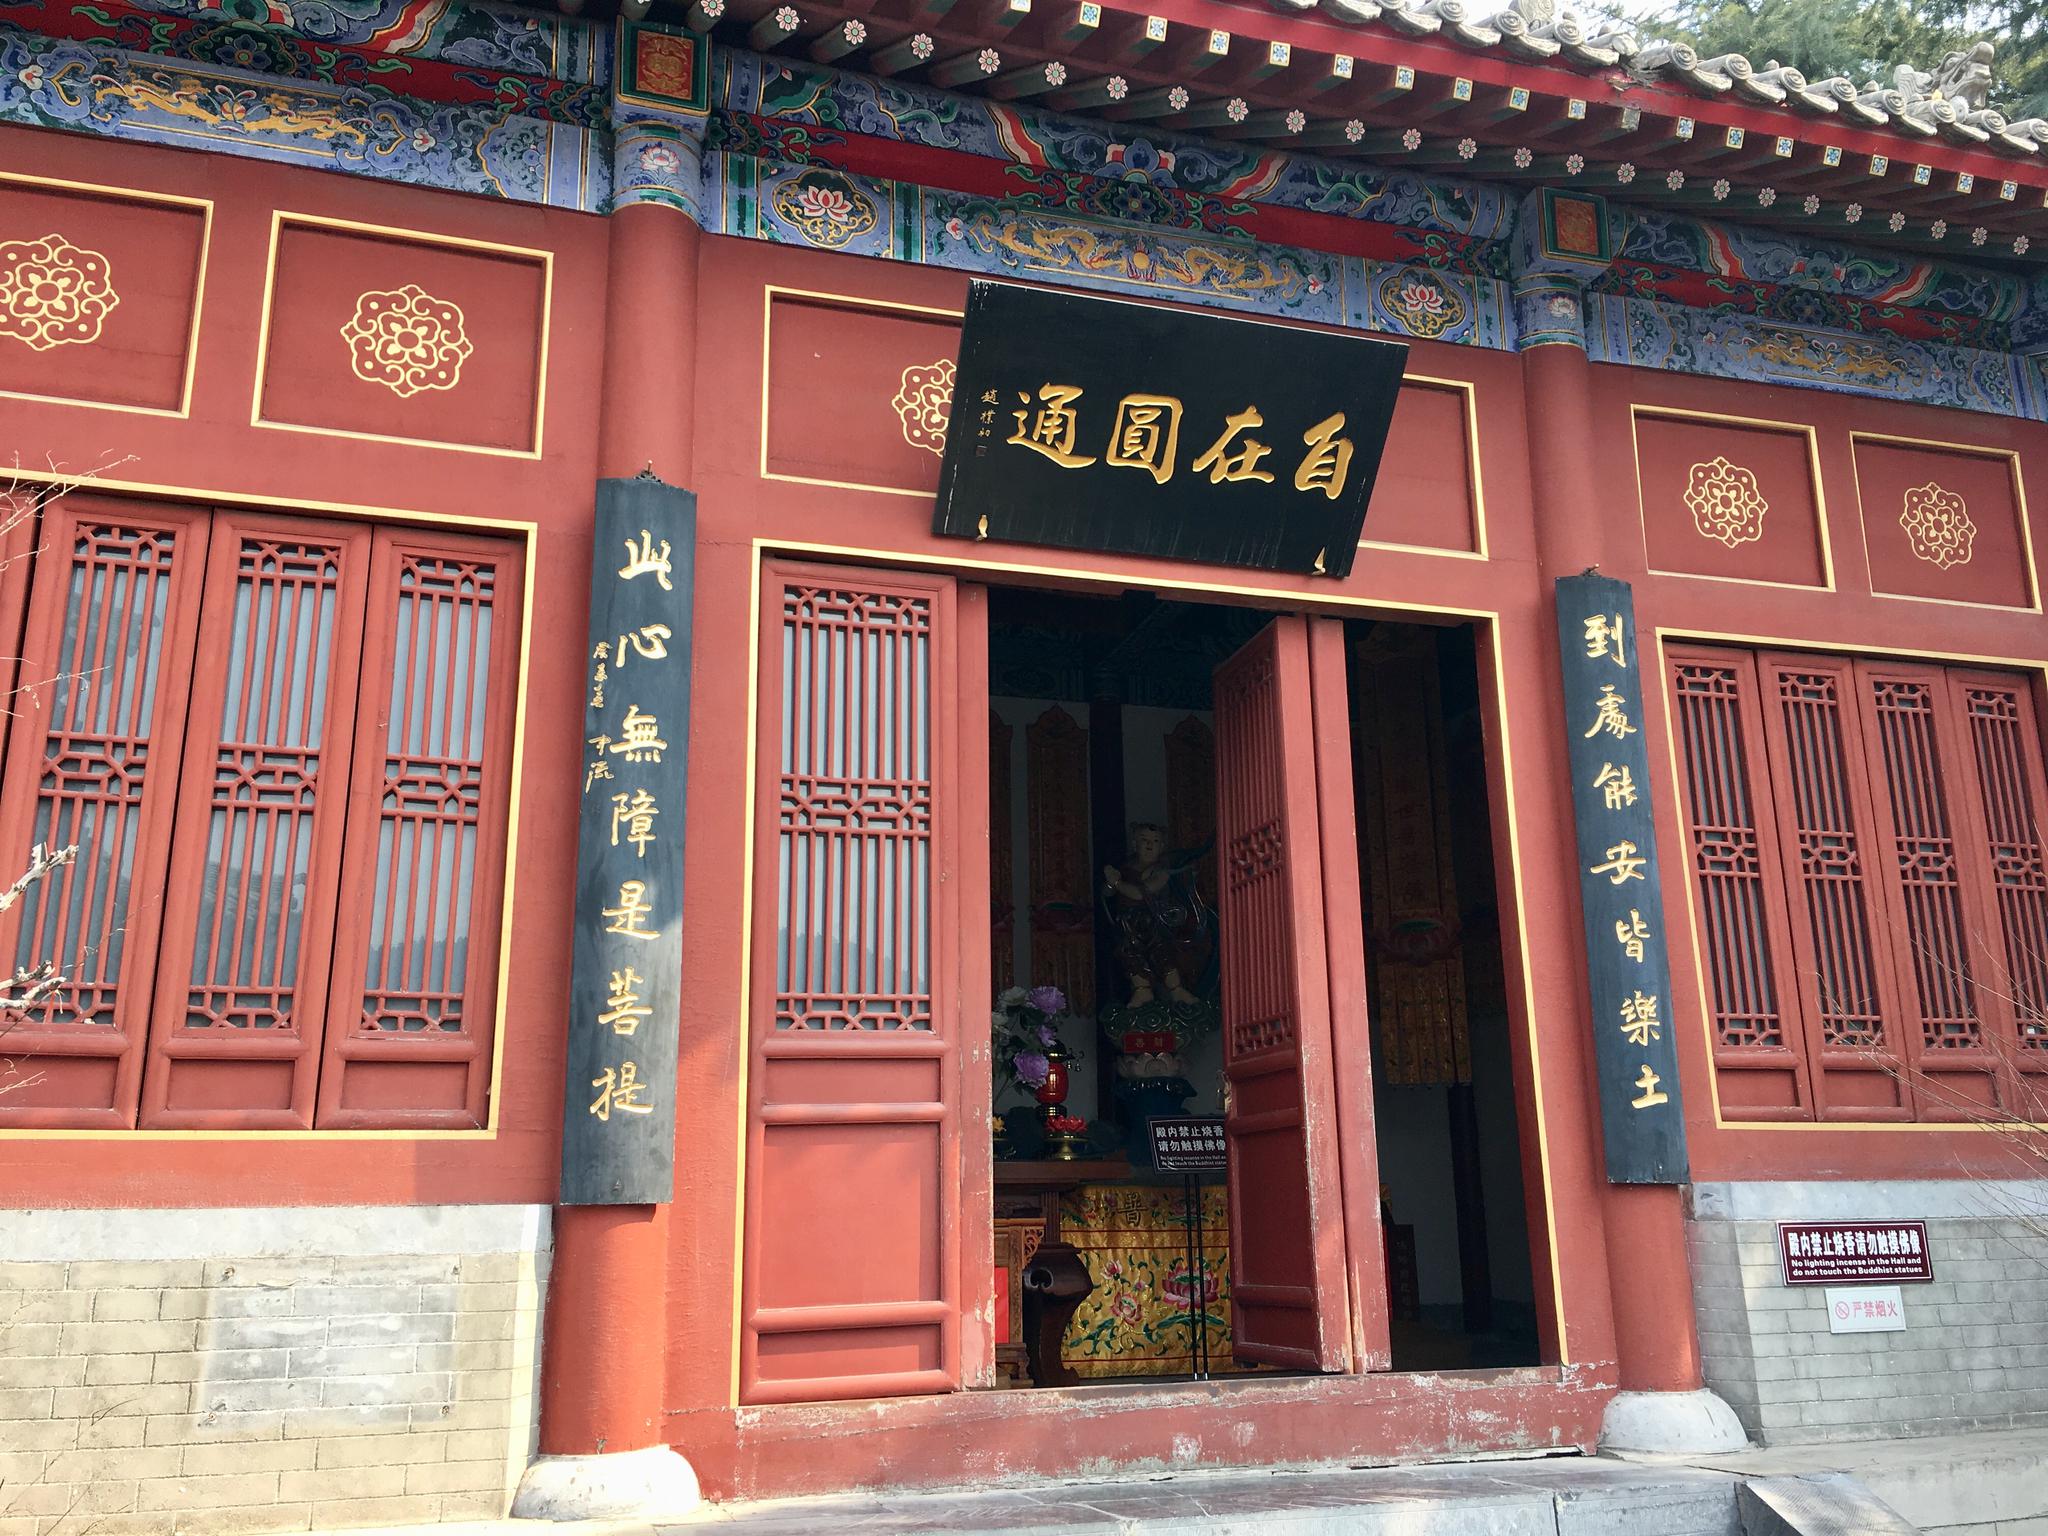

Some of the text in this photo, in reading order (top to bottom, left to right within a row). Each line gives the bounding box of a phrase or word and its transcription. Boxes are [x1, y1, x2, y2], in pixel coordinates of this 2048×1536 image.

[1006, 382, 1354, 500] 自在圓通
[1791, 1256, 1922, 1268] No lighting incense in the Hall and
[1843, 1267, 1857, 1275] the
[1857, 1266, 1893, 1275] Buddhist
[1894, 1266, 1923, 1274] statues
[1852, 1300, 1898, 1319] 严禁烟火
